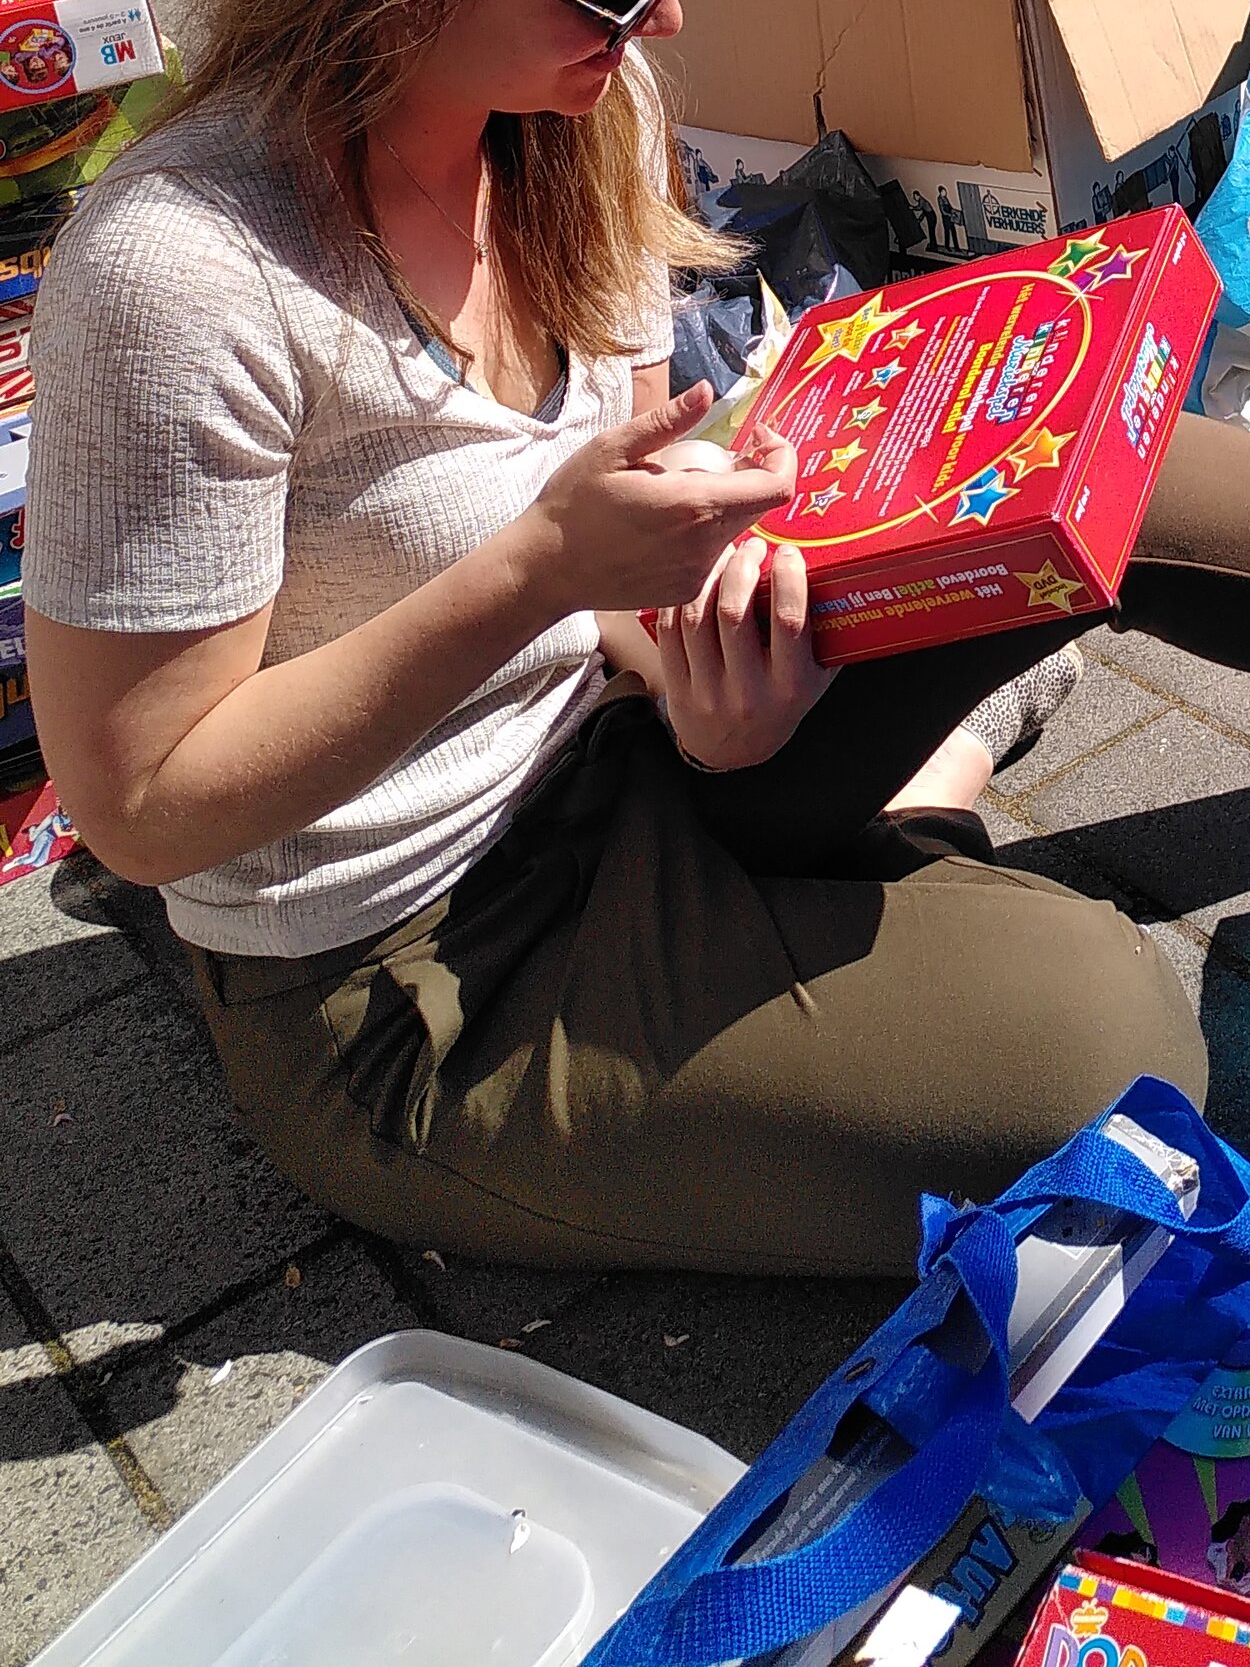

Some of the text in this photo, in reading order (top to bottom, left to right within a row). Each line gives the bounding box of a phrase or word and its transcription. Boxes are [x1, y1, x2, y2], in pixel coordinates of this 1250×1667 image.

[102, 32, 126, 44] JEUX
[99, 39, 136, 66] MB
[986, 216, 1046, 234] VERHUIZERS
[1016, 281, 1035, 304] Hét
[987, 302, 1024, 369] wervelende
[986, 334, 1030, 420] Muziekspel
[998, 324, 1052, 422] kinderen
[1017, 319, 1070, 417] kinderen
[1116, 324, 1158, 422] Muziekspel
[941, 341, 993, 434] Boordevol actie!
[957, 367, 997, 434] muziekspel
[1126, 338, 1172, 443] kinderen
[1135, 355, 1181, 459] kinderen
[945, 433, 966, 461] voor
[936, 562, 1007, 588] Boordevol
[1033, 574, 1057, 590] DVD
[864, 587, 891, 603] Ben
[886, 588, 975, 616] wervelende
[974, 581, 1002, 598] Hét
[1193, 1396, 1218, 1416] MET
[1213, 1425, 1241, 1439] VAN
